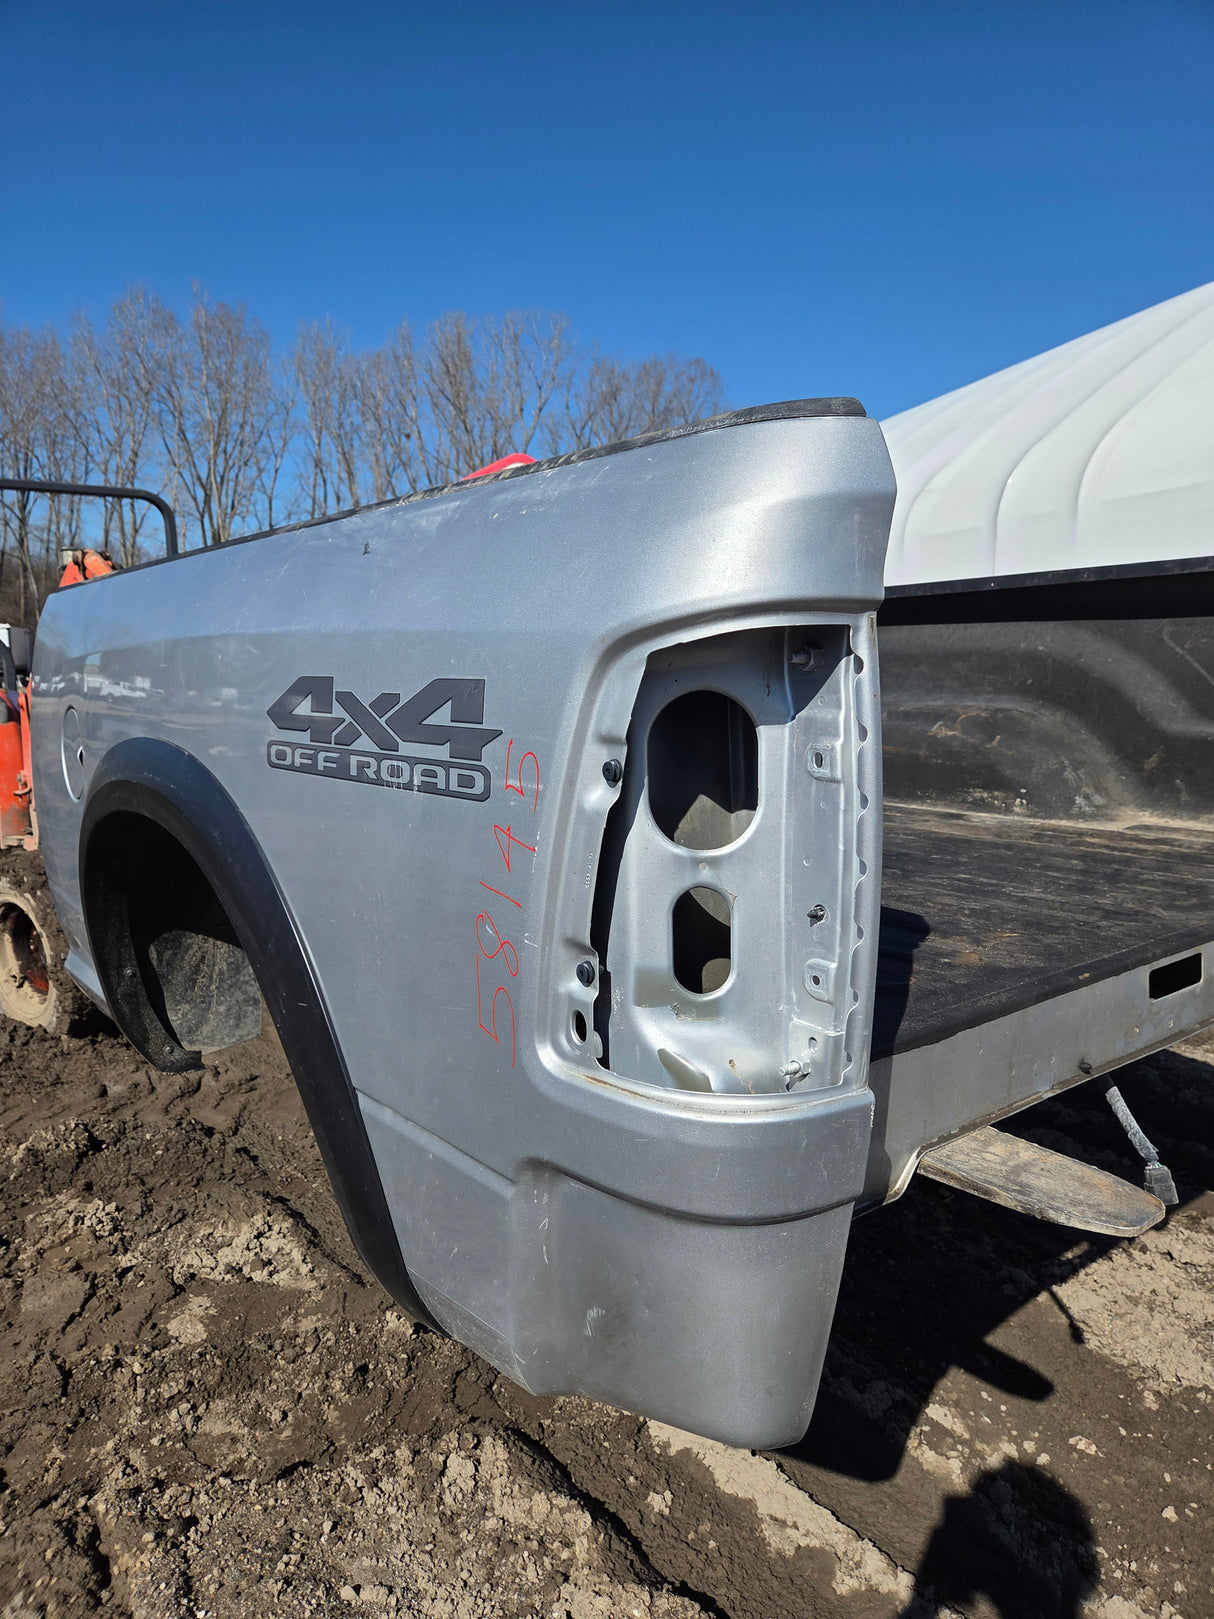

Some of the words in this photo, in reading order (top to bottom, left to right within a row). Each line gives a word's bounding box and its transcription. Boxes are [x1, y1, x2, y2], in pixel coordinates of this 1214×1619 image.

[270, 745, 342, 772] OFF
[349, 754, 486, 796] ROAD
[475, 738, 541, 1068] 58145
